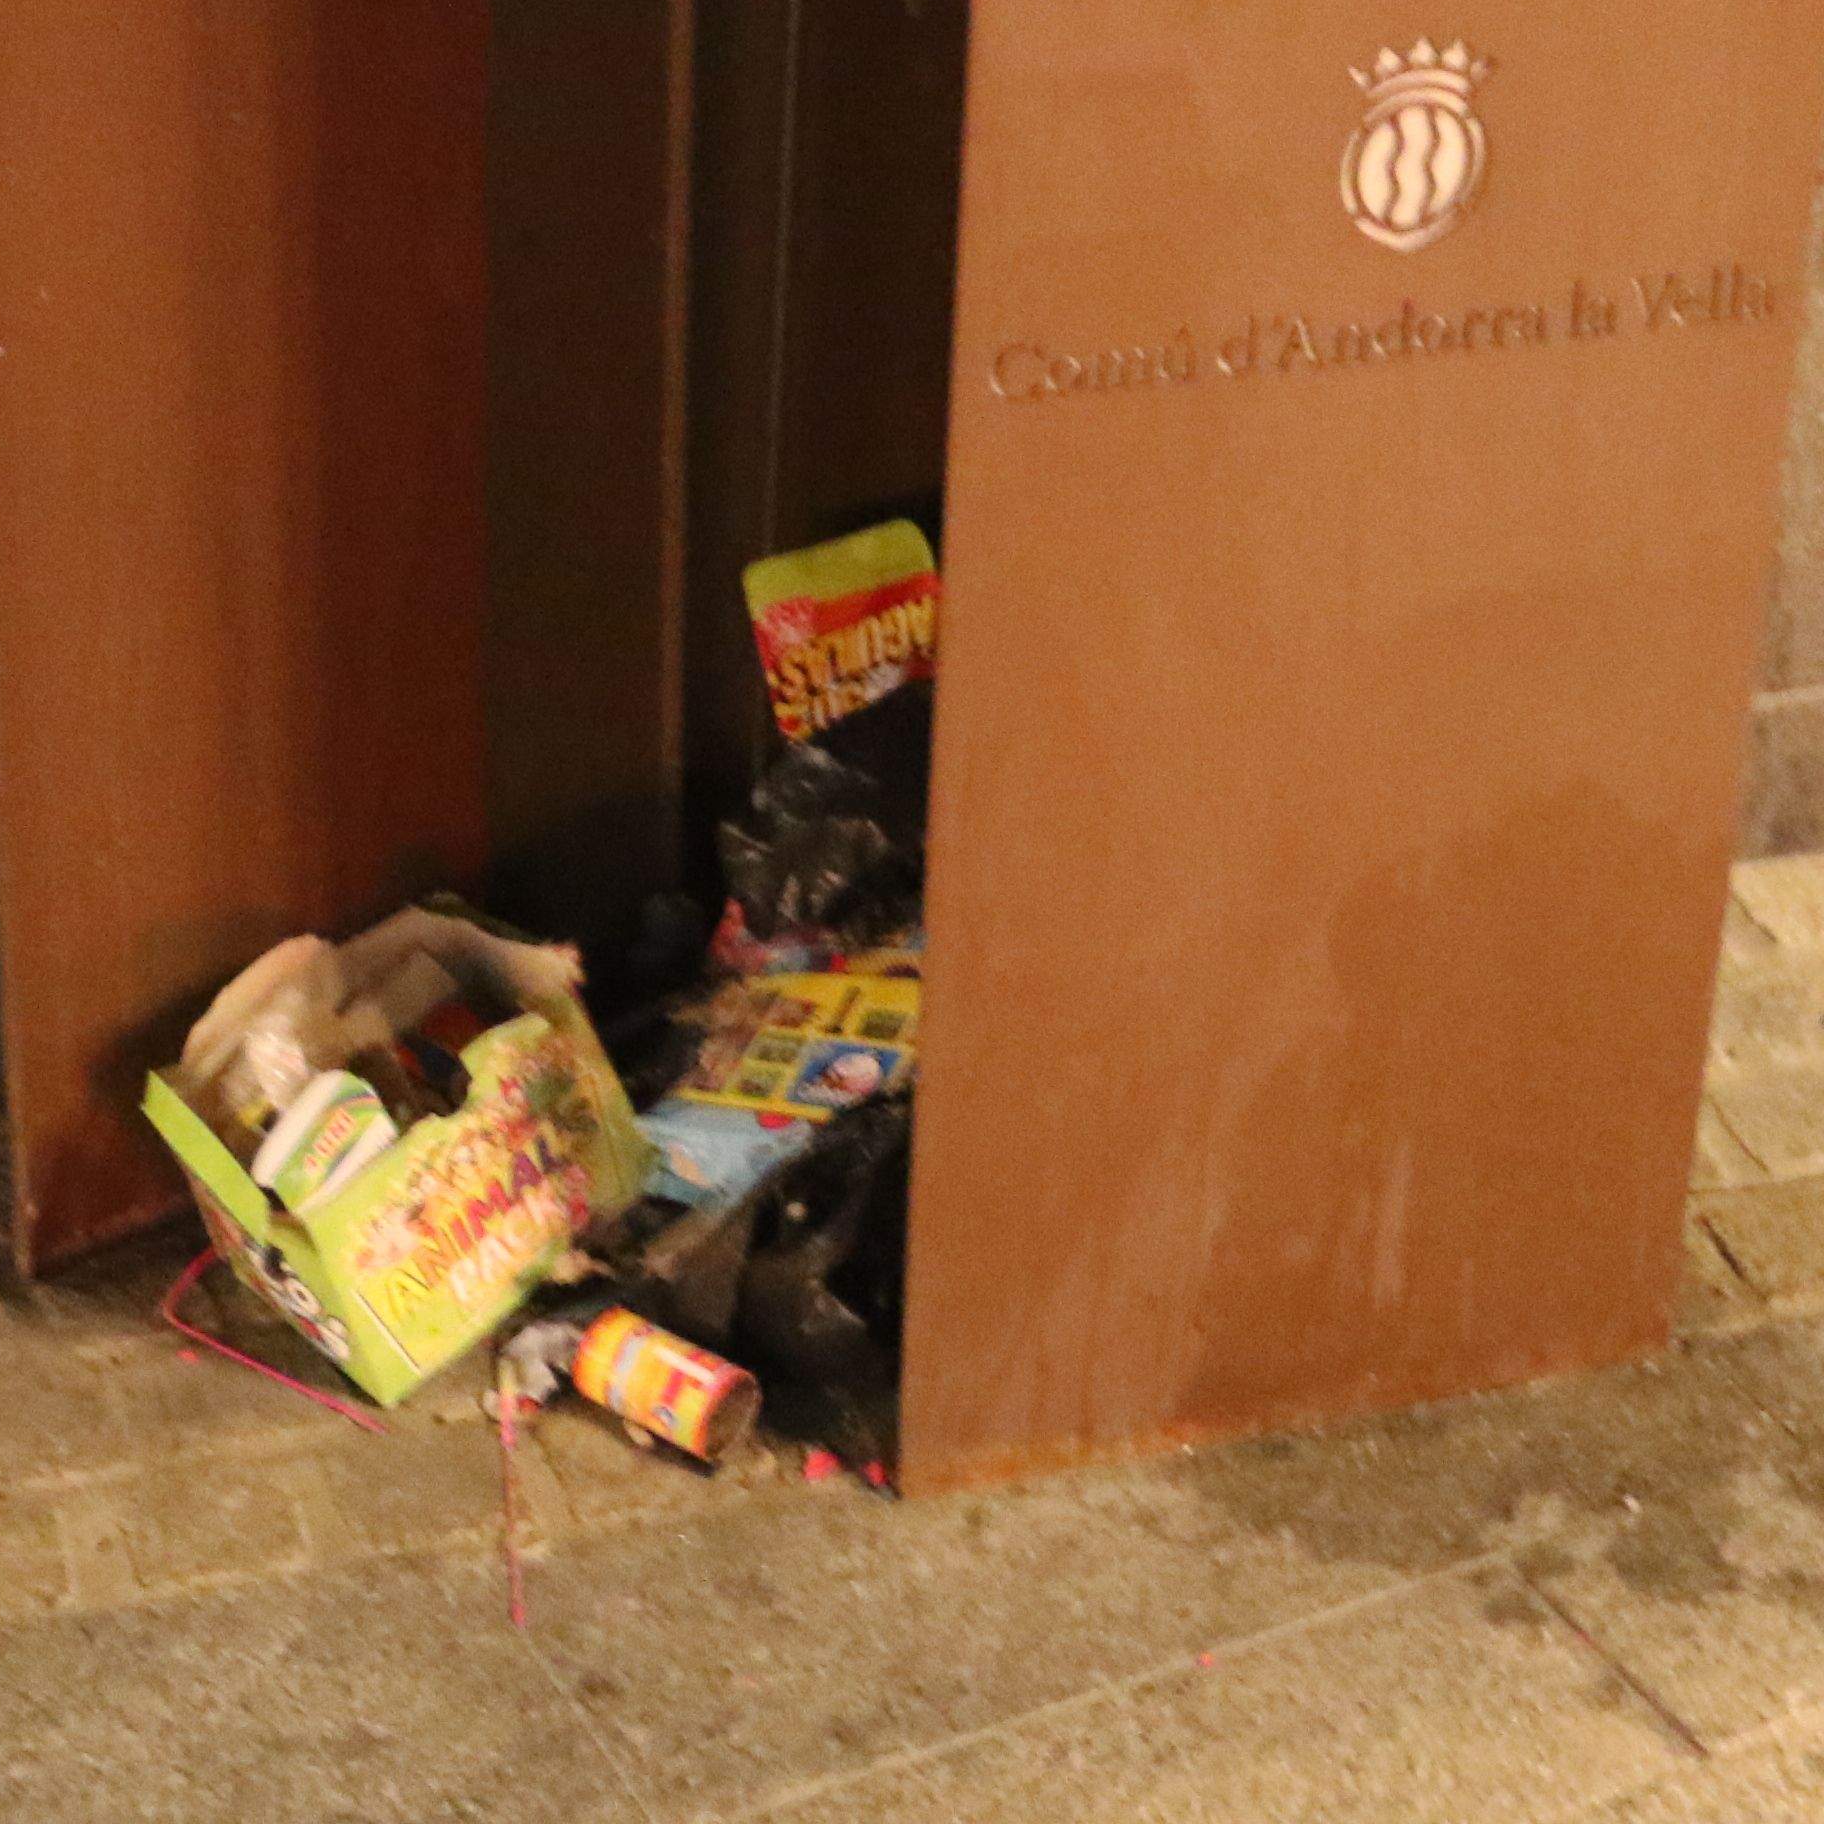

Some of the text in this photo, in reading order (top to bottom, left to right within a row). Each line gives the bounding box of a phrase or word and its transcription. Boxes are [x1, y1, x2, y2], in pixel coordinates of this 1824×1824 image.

[990, 261, 1778, 404] Comú d'Andorra la Vella
[384, 1132, 568, 1326] ANIMAL
